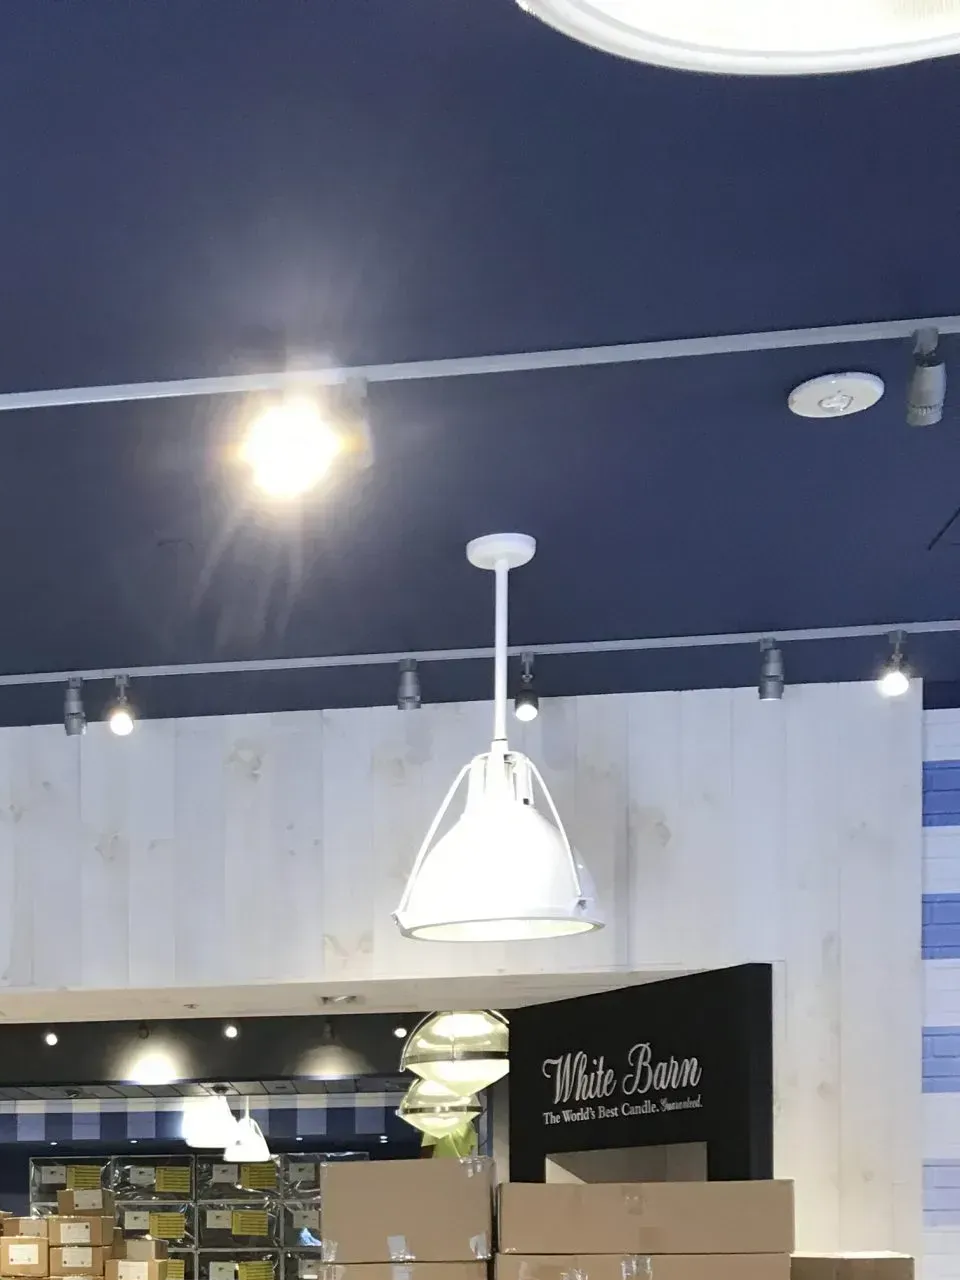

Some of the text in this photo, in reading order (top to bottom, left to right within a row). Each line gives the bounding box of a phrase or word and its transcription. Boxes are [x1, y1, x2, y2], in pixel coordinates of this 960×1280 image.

[542, 1041, 703, 1104] White Barn
[543, 1111, 561, 1125] The
[562, 1106, 596, 1123] World's
[598, 1104, 619, 1119] Best
[621, 1099, 659, 1116] Candle.
